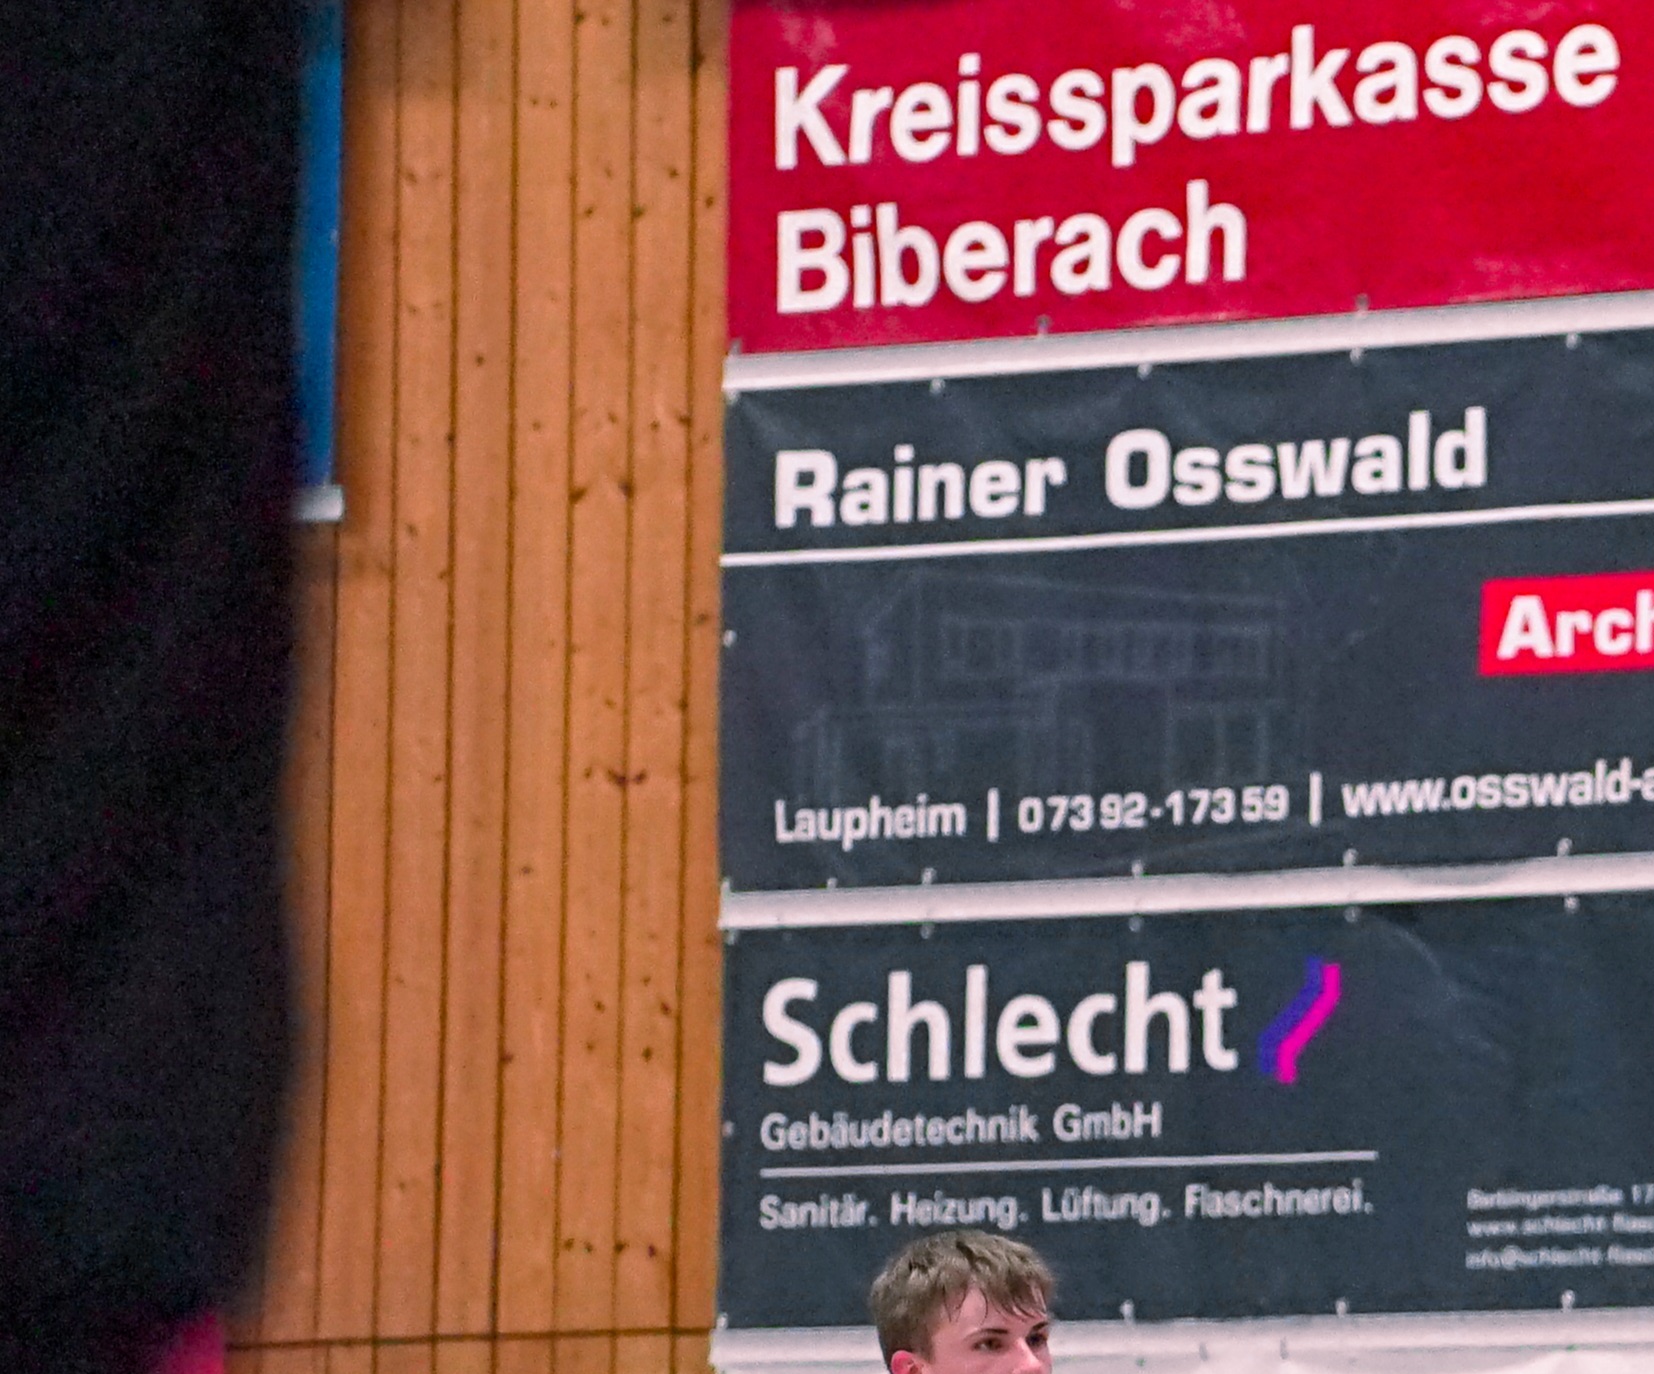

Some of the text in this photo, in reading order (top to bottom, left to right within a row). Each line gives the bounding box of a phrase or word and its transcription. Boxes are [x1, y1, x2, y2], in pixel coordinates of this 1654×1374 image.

[773, 22, 1621, 170] Kreissparkasse
[776, 180, 1248, 315] Biberach
[773, 407, 1487, 529] Rainer Osswald
[774, 794, 968, 852] Laupheim
[762, 961, 1238, 1087] Schlecht
[760, 1101, 1163, 1152] Gebäudetechnik GmbH
[760, 1177, 1374, 1231] Sanitär. Heizung. Lüftung. Flaschnerei.
